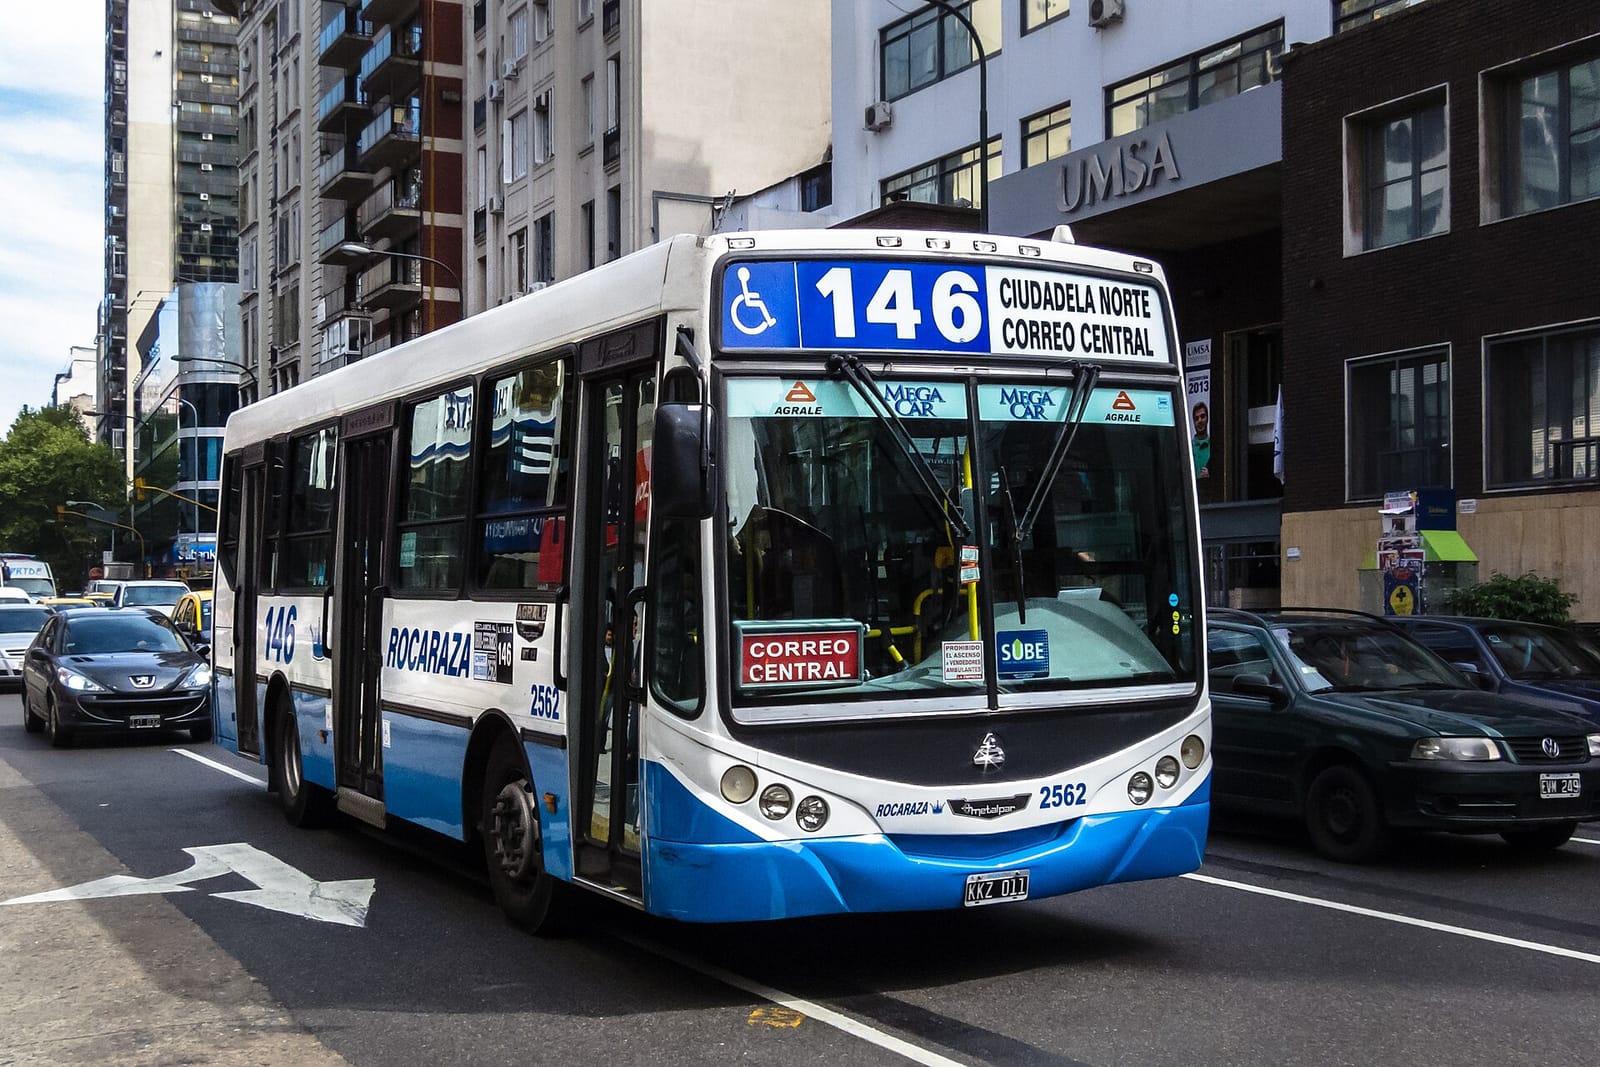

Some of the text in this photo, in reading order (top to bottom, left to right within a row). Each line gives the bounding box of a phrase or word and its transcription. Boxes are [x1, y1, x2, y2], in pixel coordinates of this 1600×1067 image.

[1057, 130, 1179, 213] UMSA
[815, 266, 982, 343] 146
[1000, 277, 1151, 318] CIUDADELA NORTE
[1002, 318, 1154, 356] CORREO CENTRAL
[1187, 344, 1210, 356] UMSA
[884, 384, 946, 402] MEGA
[1000, 388, 1056, 406] MEGA
[1188, 381, 1209, 394] 2013
[774, 407, 822, 415] AGRALE
[894, 401, 938, 417] CAR
[1010, 403, 1048, 420] CAR
[1105, 414, 1141, 422] AGRALE
[516, 605, 547, 620] AGRALE
[265, 605, 297, 664] 146
[498, 626, 513, 634] LINEA
[387, 628, 471, 678] ROCARAZA
[498, 642, 512, 667] 146
[749, 639, 850, 658] CORREO
[1001, 640, 1045, 661] SUBE
[749, 661, 851, 681] CENTRAL
[530, 685, 560, 720] 2562
[1039, 783, 1087, 808] 2562
[1561, 780, 1579, 793] 249
[876, 802, 928, 817] ROCARAZA
[968, 878, 1025, 900] KKZ 011
